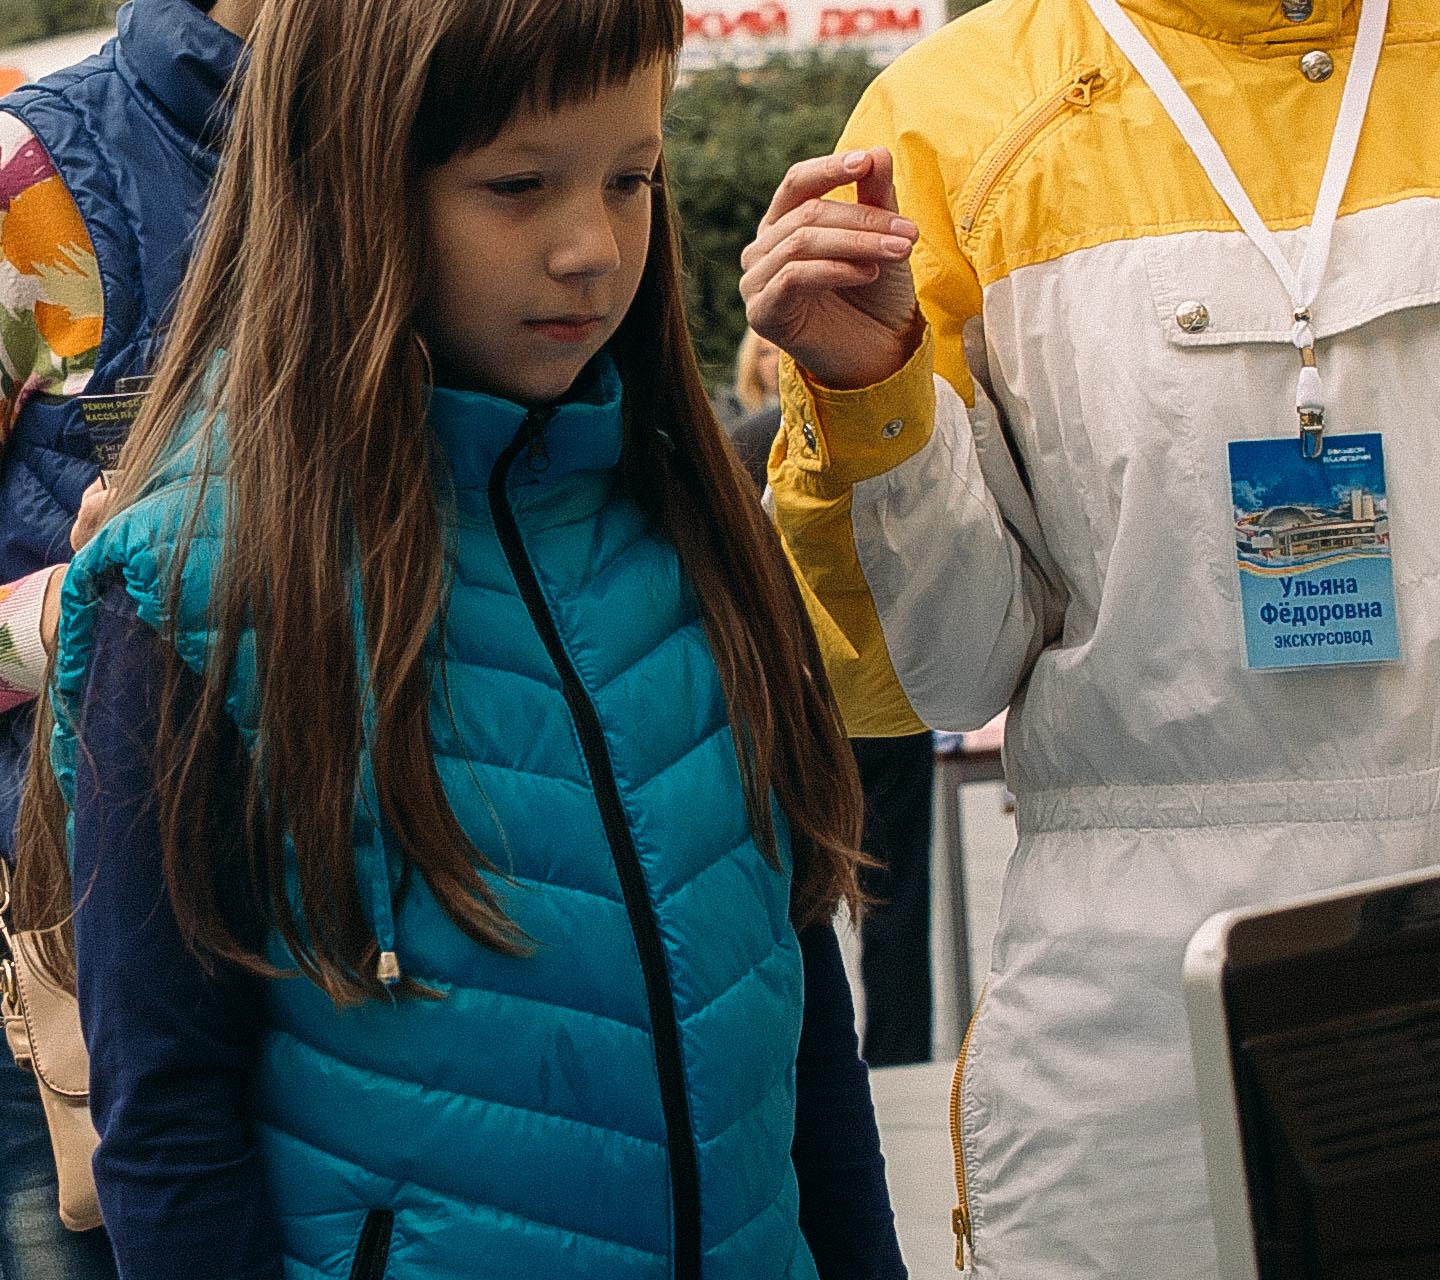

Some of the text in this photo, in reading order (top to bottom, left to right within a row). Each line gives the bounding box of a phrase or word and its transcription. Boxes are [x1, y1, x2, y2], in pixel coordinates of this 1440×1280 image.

[817, 6, 922, 41] ДОМ
[1278, 576, 1358, 598] Ульяна
[1259, 600, 1383, 627] Фёдоровна
[1273, 629, 1374, 649] ЭКСКУРСОВОД
